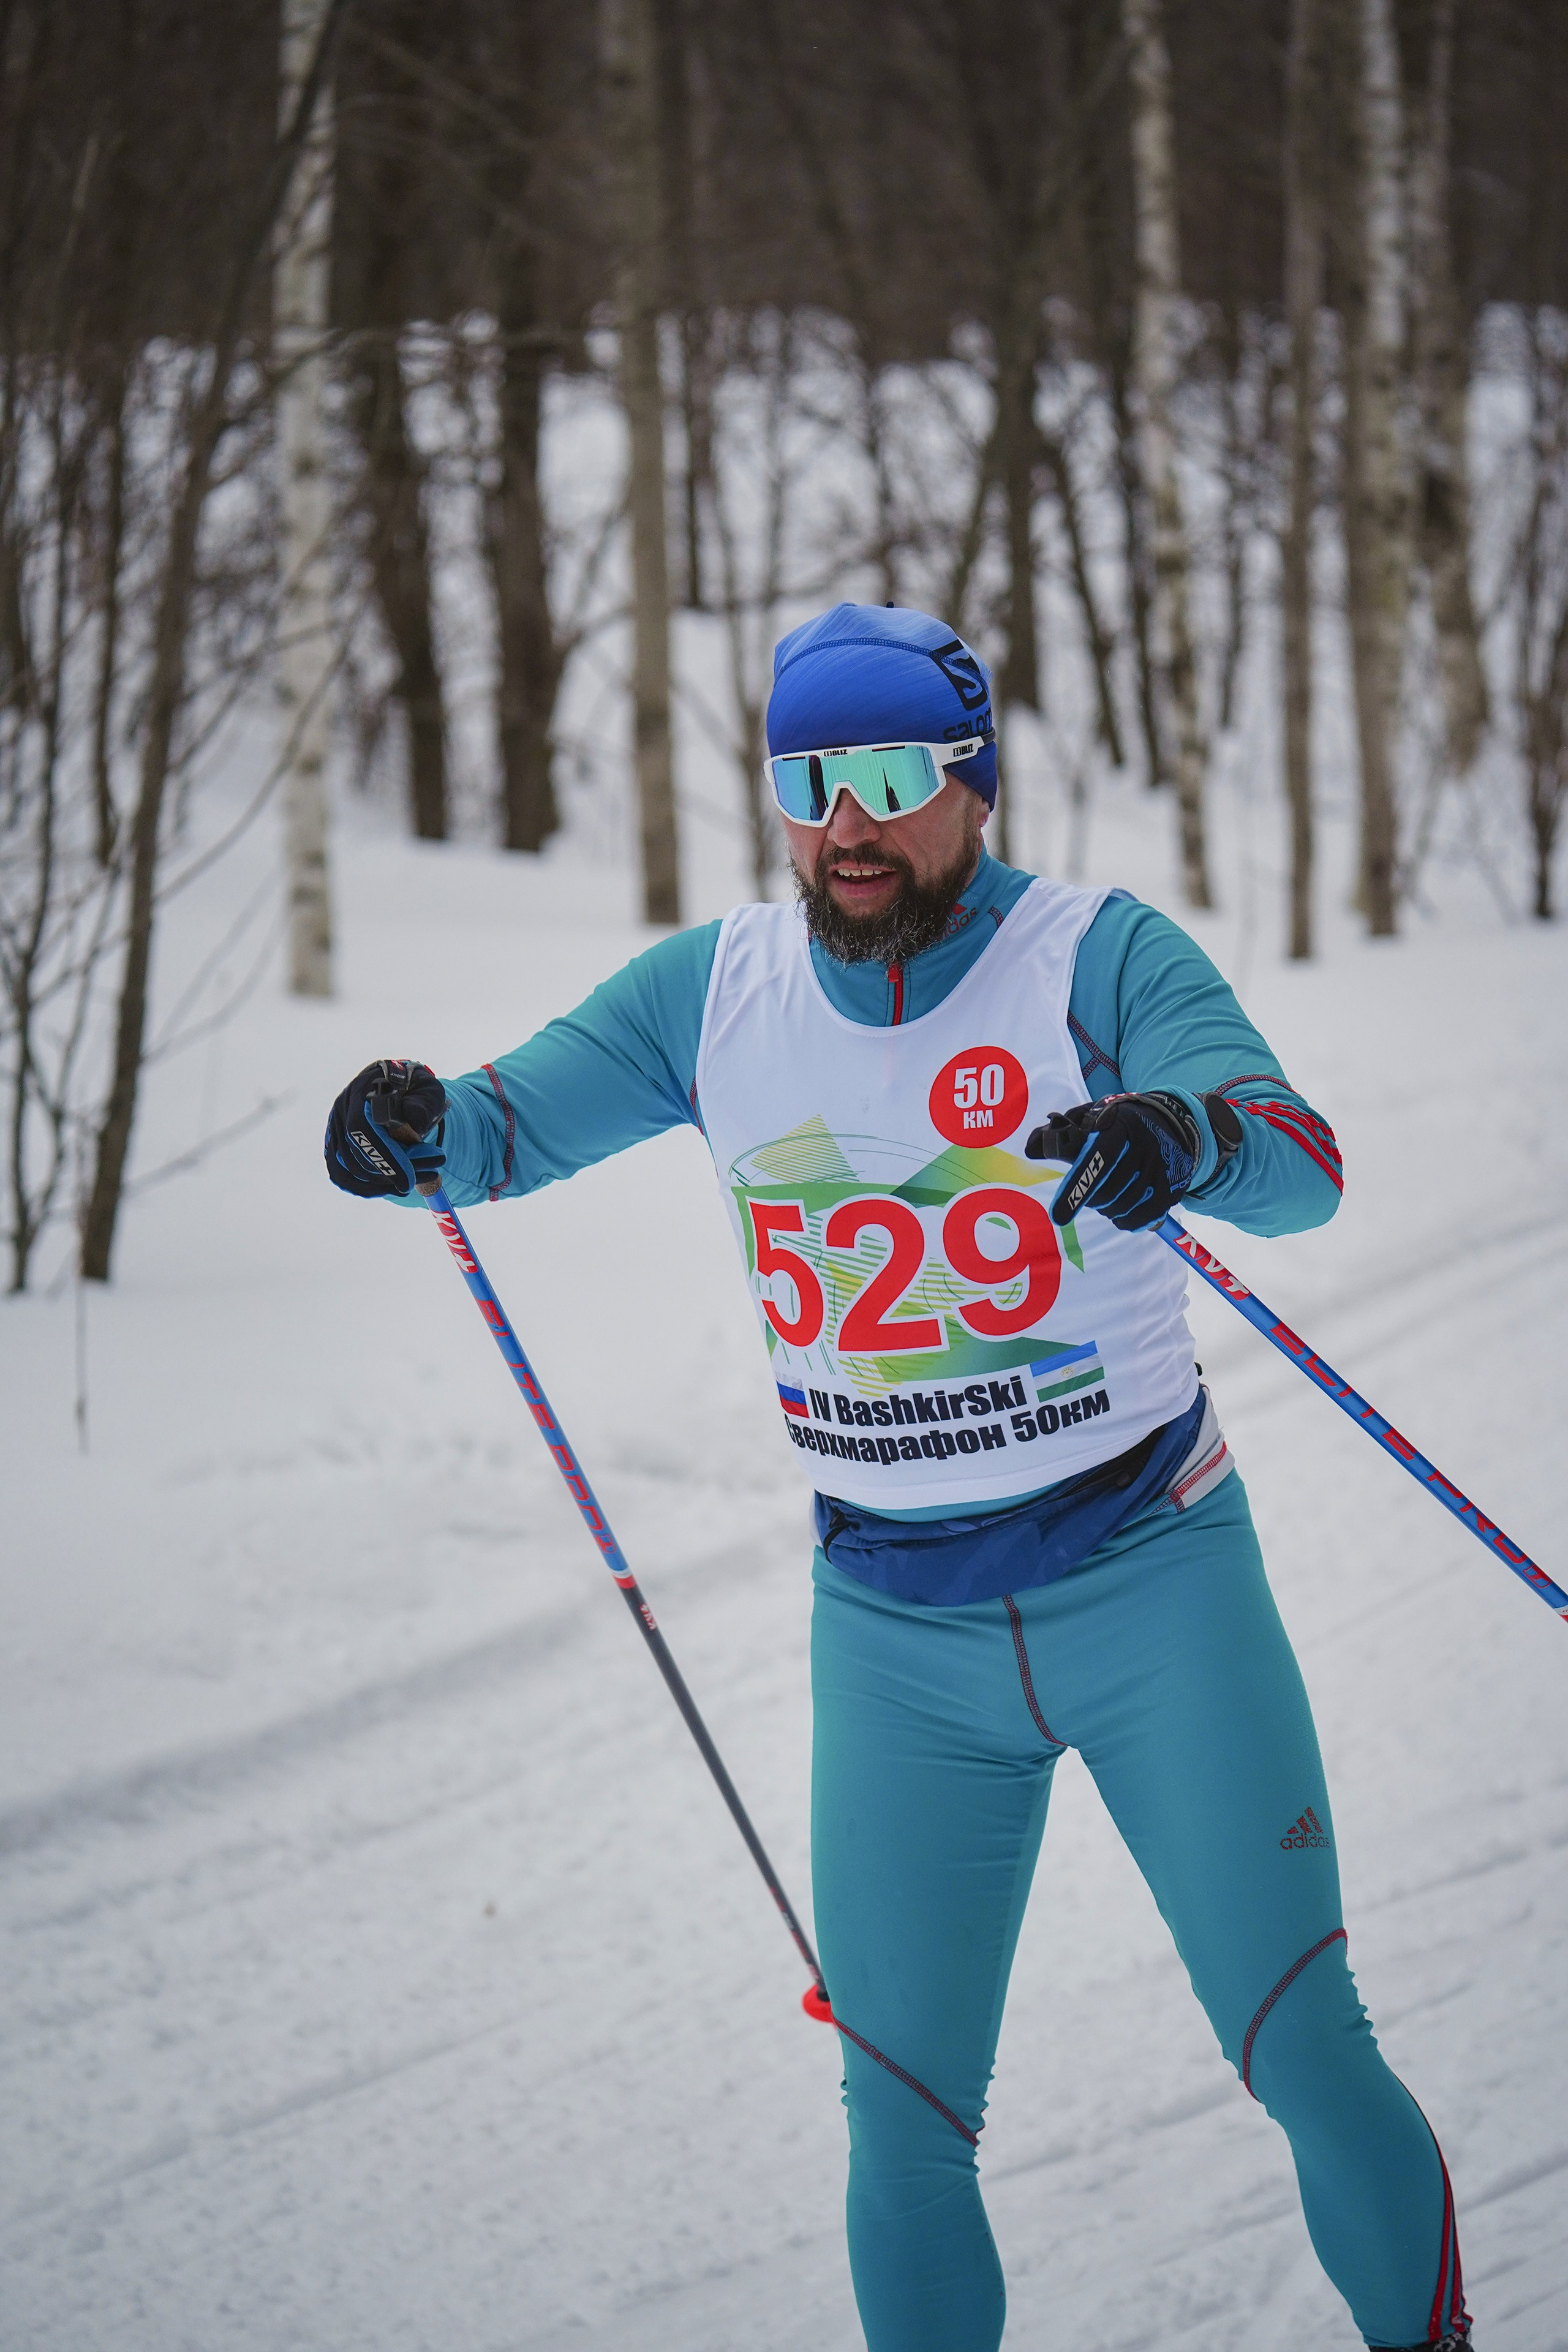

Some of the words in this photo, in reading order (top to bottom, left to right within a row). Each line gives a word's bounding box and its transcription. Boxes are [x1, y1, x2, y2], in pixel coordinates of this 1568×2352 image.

[954, 1063, 1005, 1109] 50
[748, 1187, 1062, 1351] 529
[809, 1388, 832, 1422] IV
[833, 1375, 1027, 1427] BashkirSki
[784, 1413, 1007, 1465] Сверхмарафон
[1280, 1833, 1330, 1850] adidas
